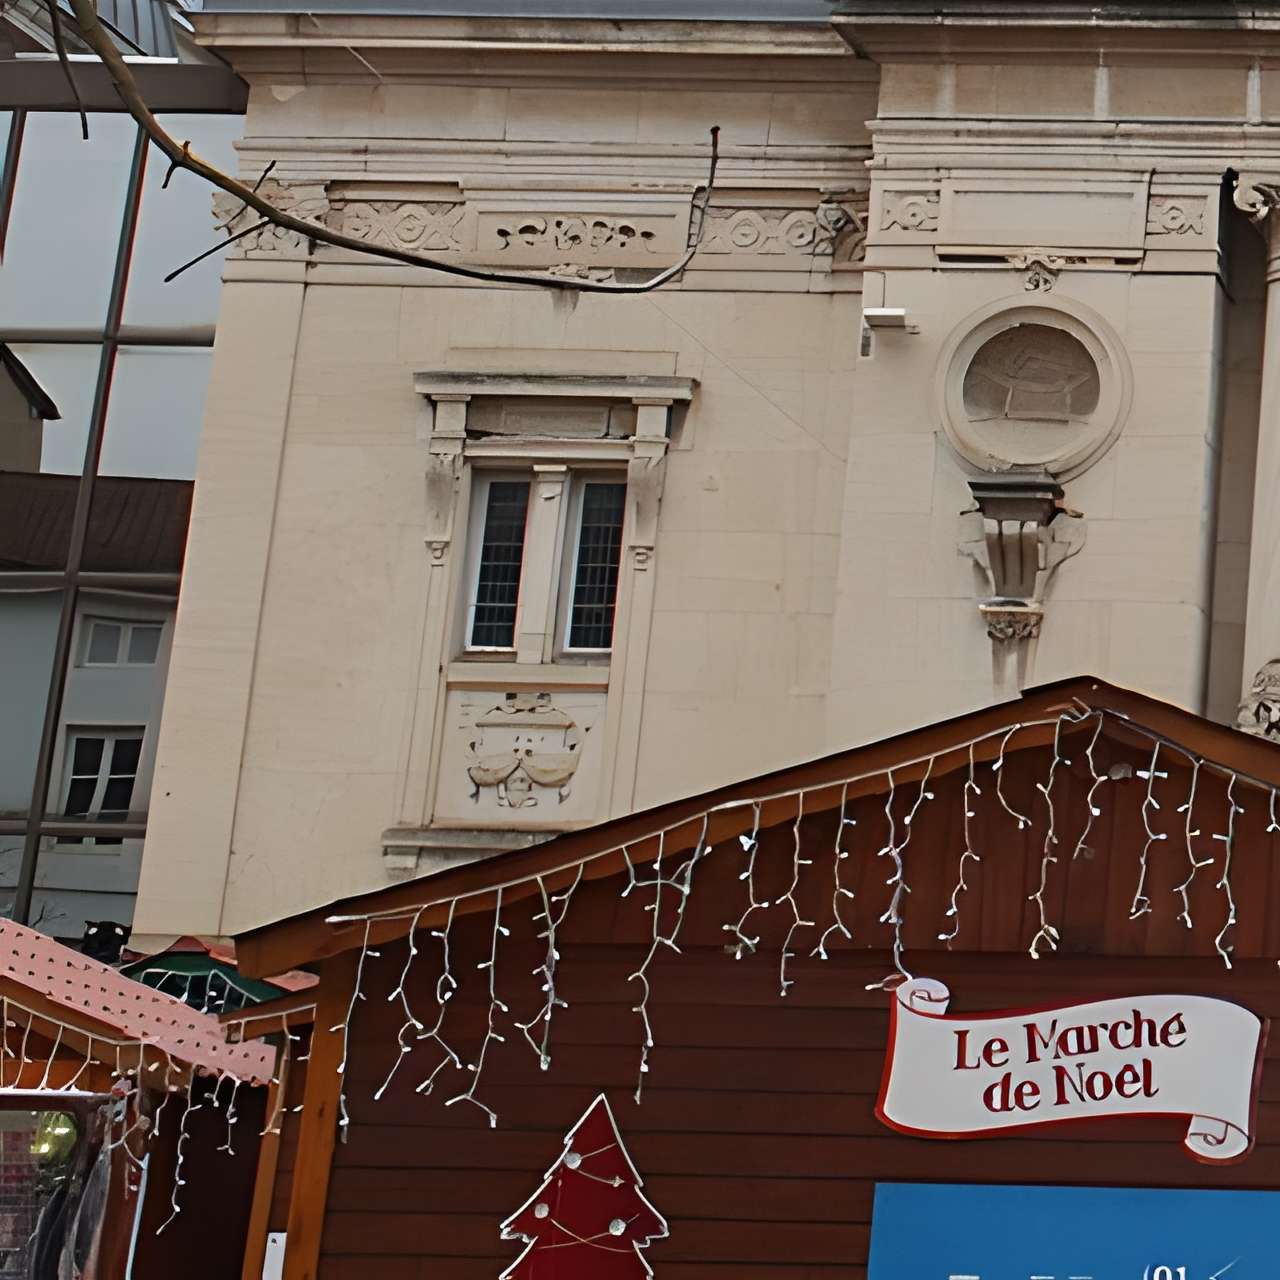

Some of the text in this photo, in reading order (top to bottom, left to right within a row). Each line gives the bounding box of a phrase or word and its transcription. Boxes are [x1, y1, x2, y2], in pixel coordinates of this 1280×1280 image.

[953, 1008, 1187, 1071] Le Marché
[982, 1072, 1041, 1113] de
